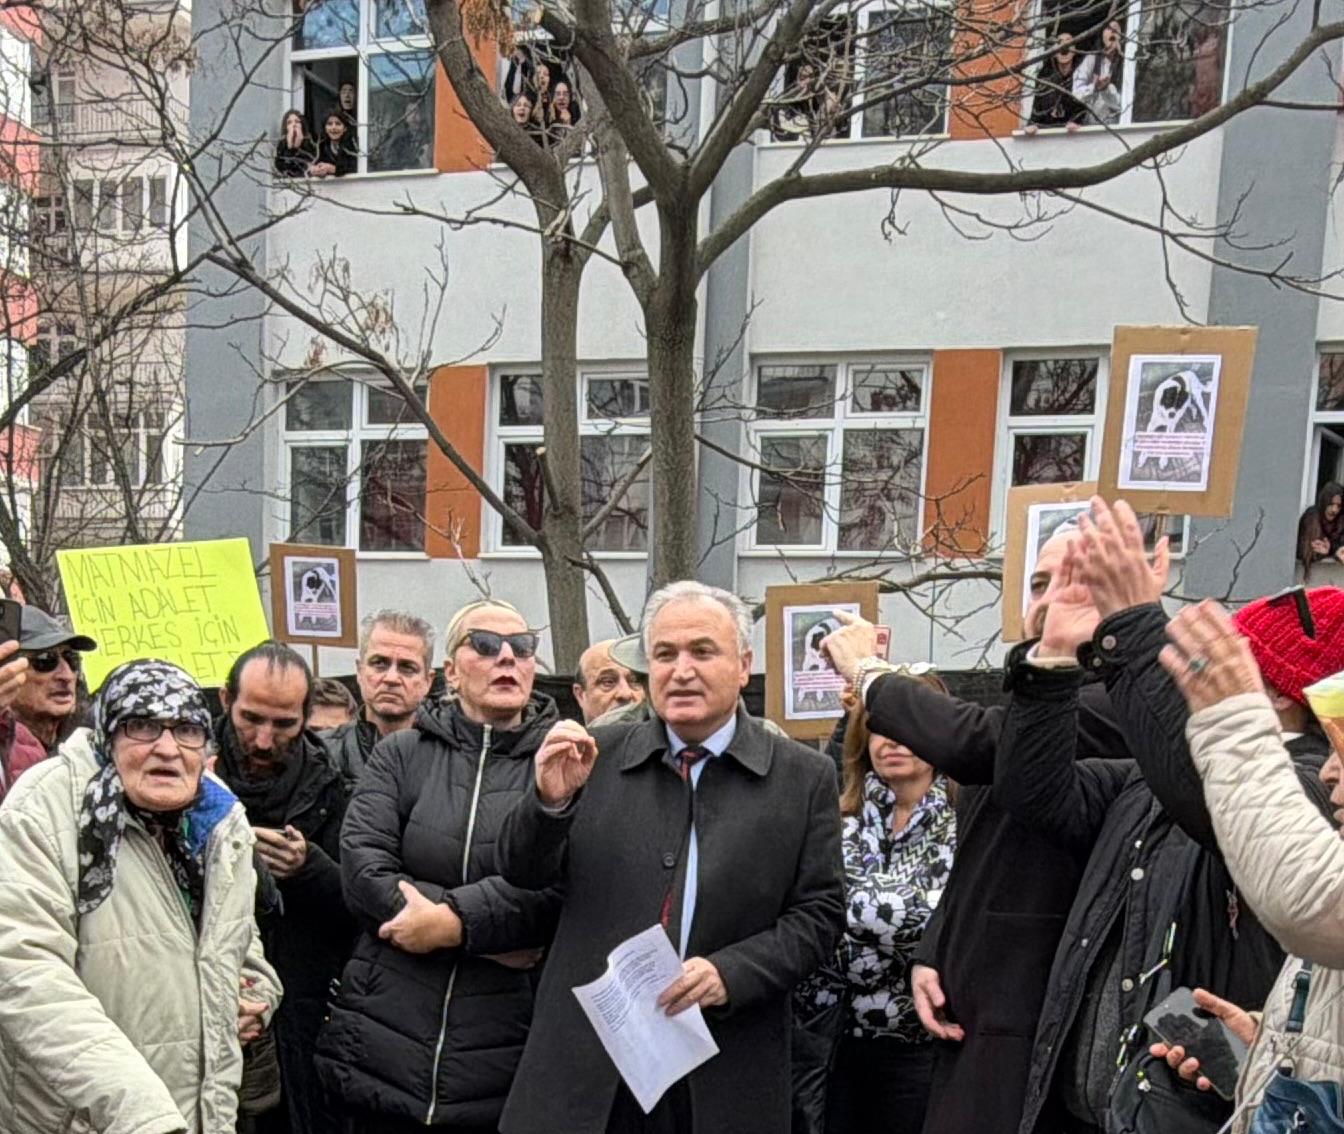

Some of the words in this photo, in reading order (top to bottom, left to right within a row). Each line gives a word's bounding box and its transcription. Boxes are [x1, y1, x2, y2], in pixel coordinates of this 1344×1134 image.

[64, 547, 217, 597] MATMAZEL
[74, 593, 117, 625] İÇİN
[128, 584, 216, 622] ADALET
[194, 613, 242, 648] İÇİN
